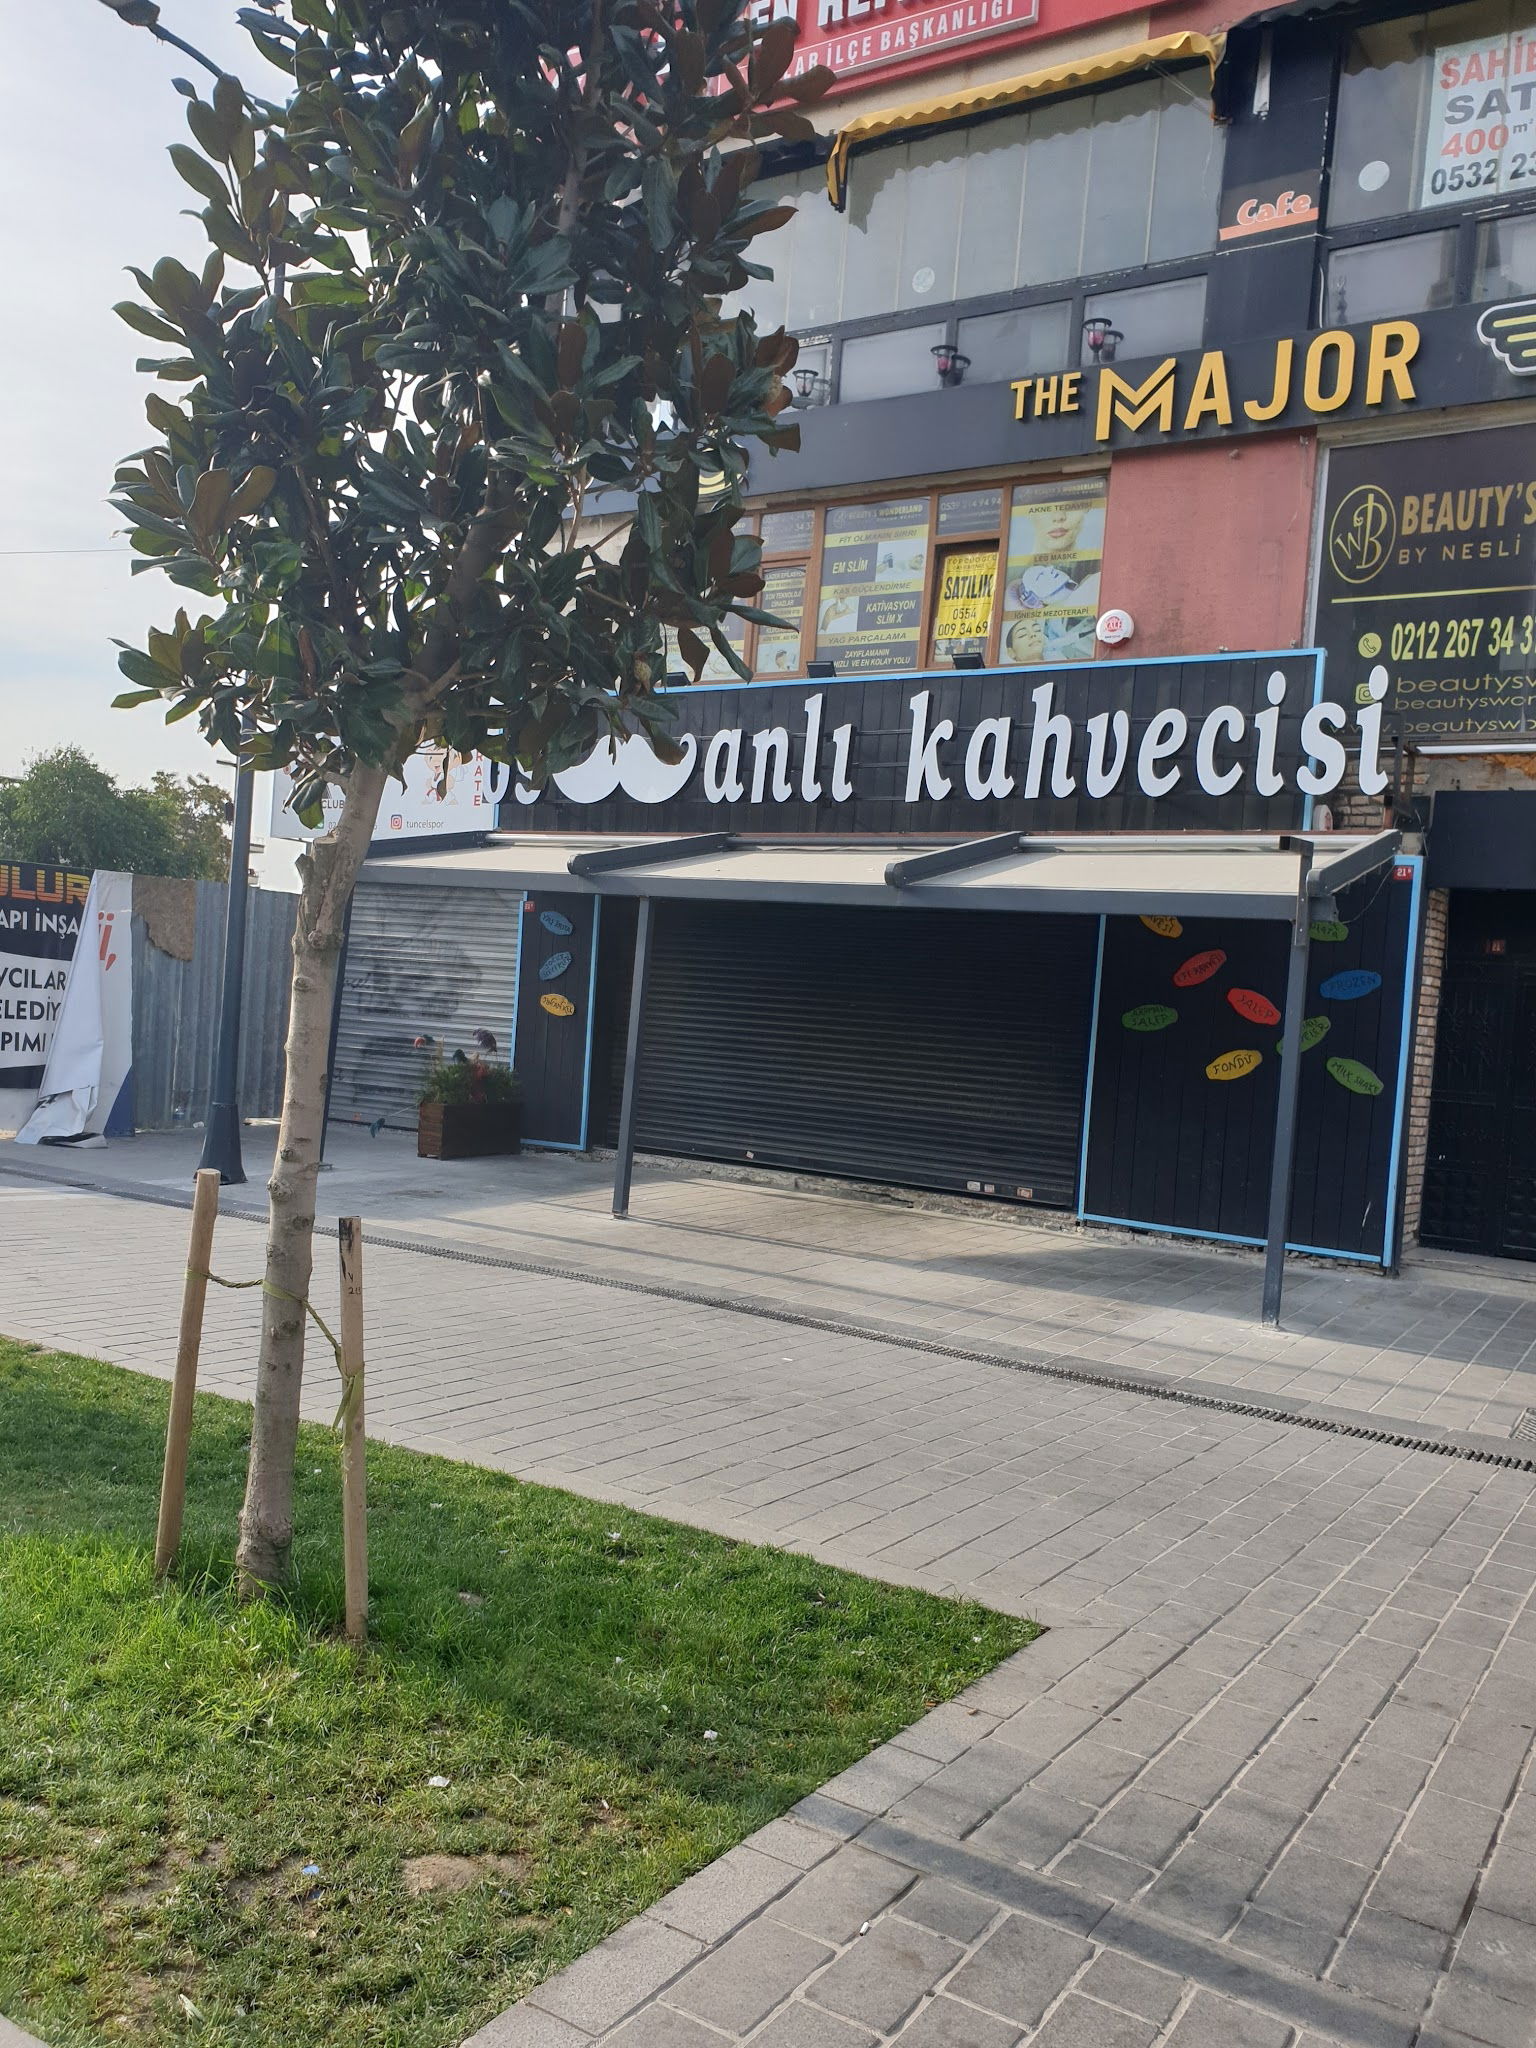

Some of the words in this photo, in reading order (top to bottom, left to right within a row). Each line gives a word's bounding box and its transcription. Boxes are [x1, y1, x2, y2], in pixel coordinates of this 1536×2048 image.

[826, 36, 872, 66] İLÇE
[1440, 125, 1509, 158] 400
[1431, 158, 1499, 195] 0532
[1237, 190, 1312, 226] Cafe
[1010, 371, 1082, 420] THE
[1095, 319, 1421, 441] MAJOR
[1398, 547, 1427, 565] BY
[1442, 534, 1521, 561] NESLİ
[832, 562, 846, 574] EM
[847, 557, 869, 573] SLİM
[944, 574, 993, 600] SATILIK
[938, 623, 957, 636] 009
[959, 622, 972, 636] 34
[975, 620, 988, 634] 69
[953, 608, 977, 620] 0554
[1391, 620, 1440, 661] 0212
[1446, 618, 1484, 657] 267
[1488, 616, 1514, 656] 34
[905, 665, 1388, 803] kahvecisi
[406, 818, 444, 830] tuncelspor
[0, 995, 61, 1021] LEDİY
